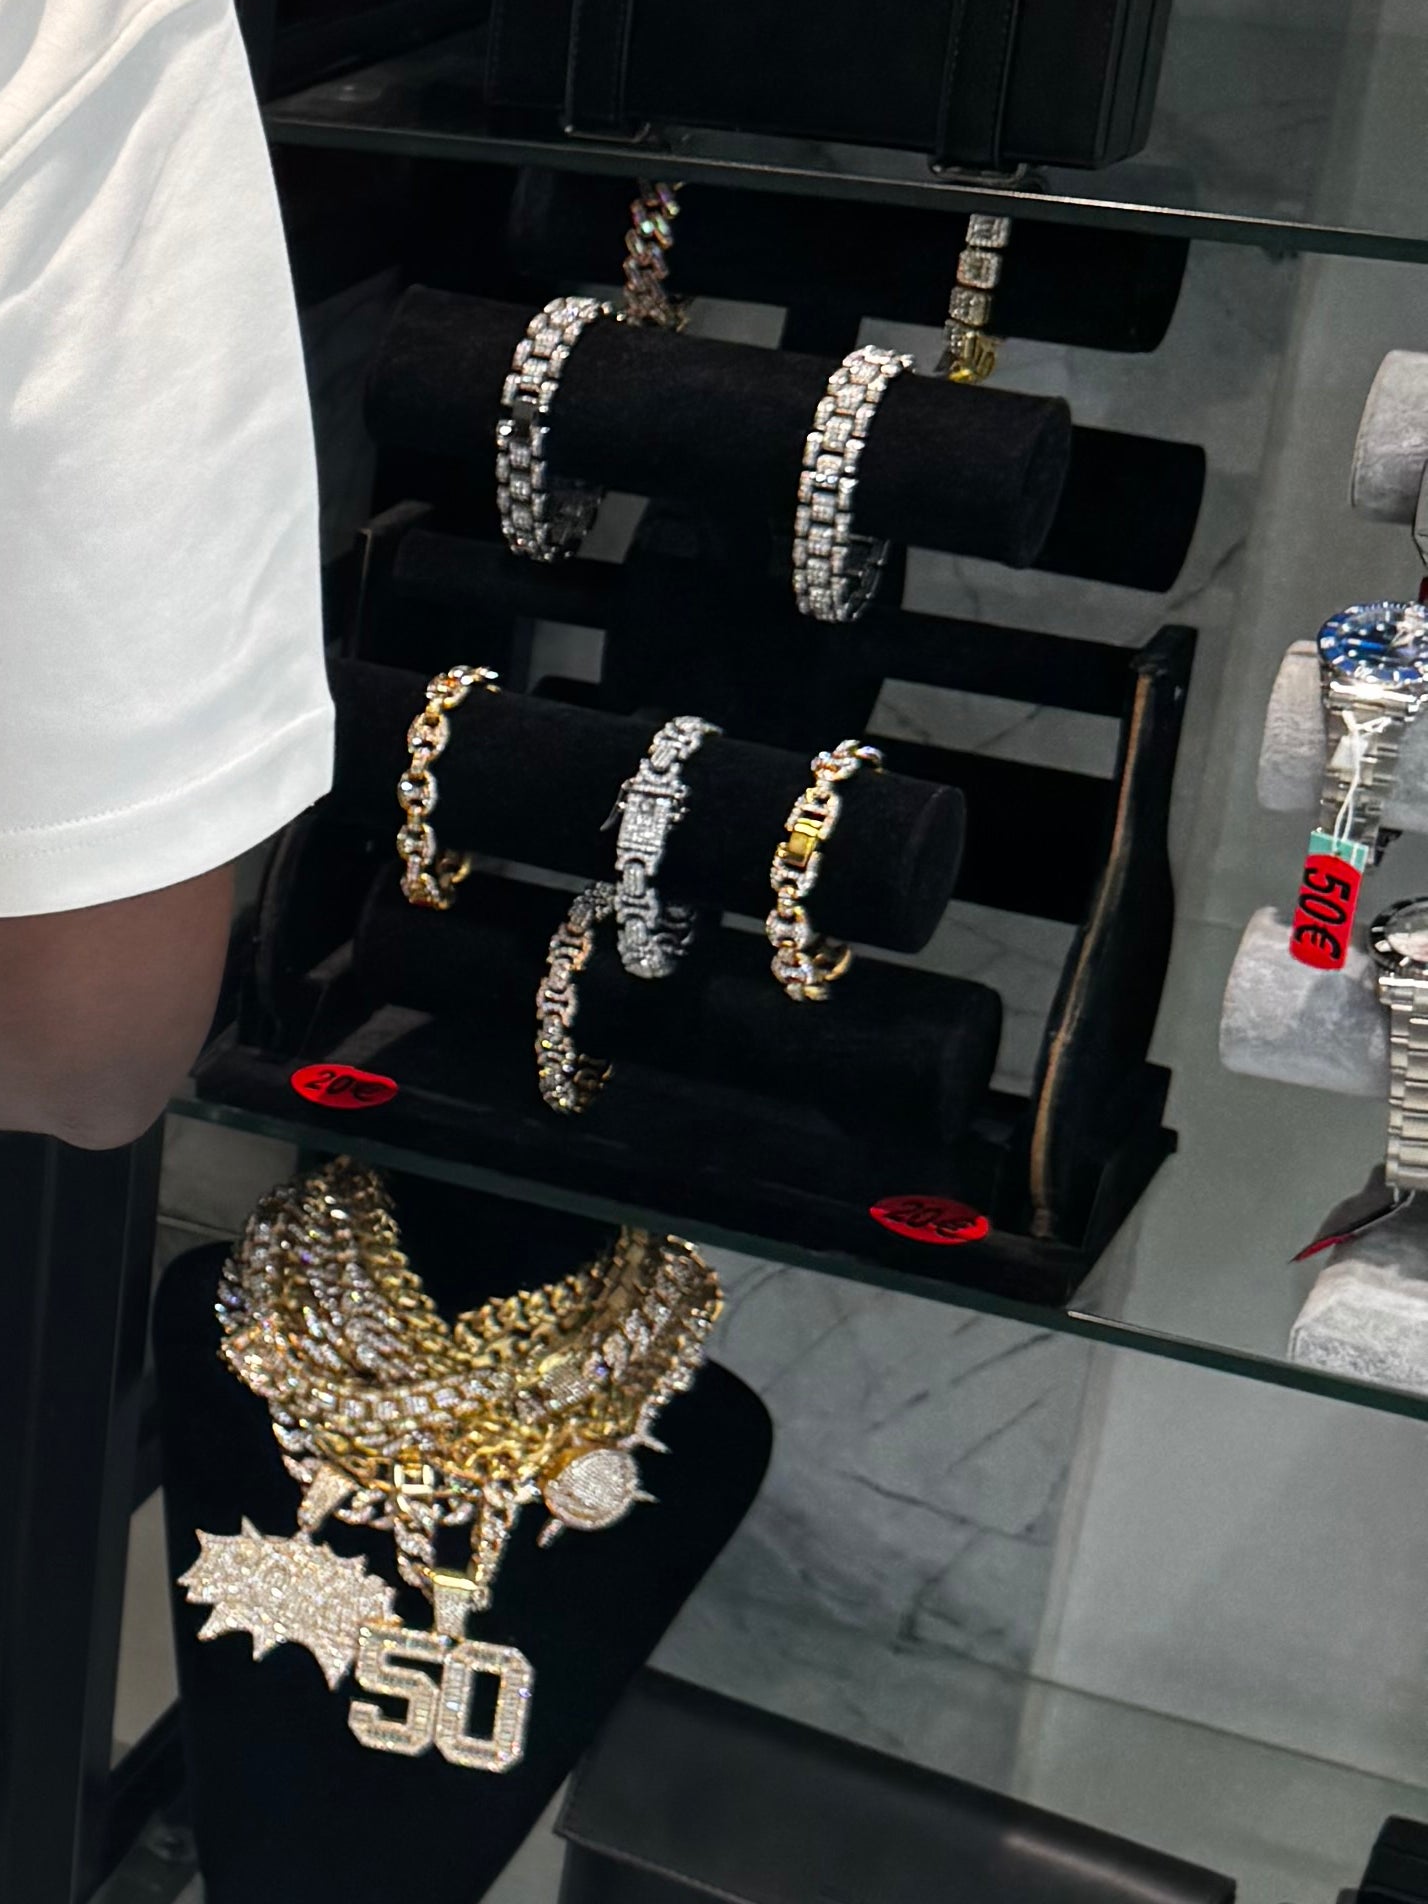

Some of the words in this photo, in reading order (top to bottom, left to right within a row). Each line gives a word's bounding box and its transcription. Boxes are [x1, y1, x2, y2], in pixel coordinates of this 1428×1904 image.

[1294, 866, 1352, 961] 50€
[303, 1068, 392, 1103] 20€
[882, 1201, 978, 1239] 20€
[348, 1626, 534, 1774] 50
